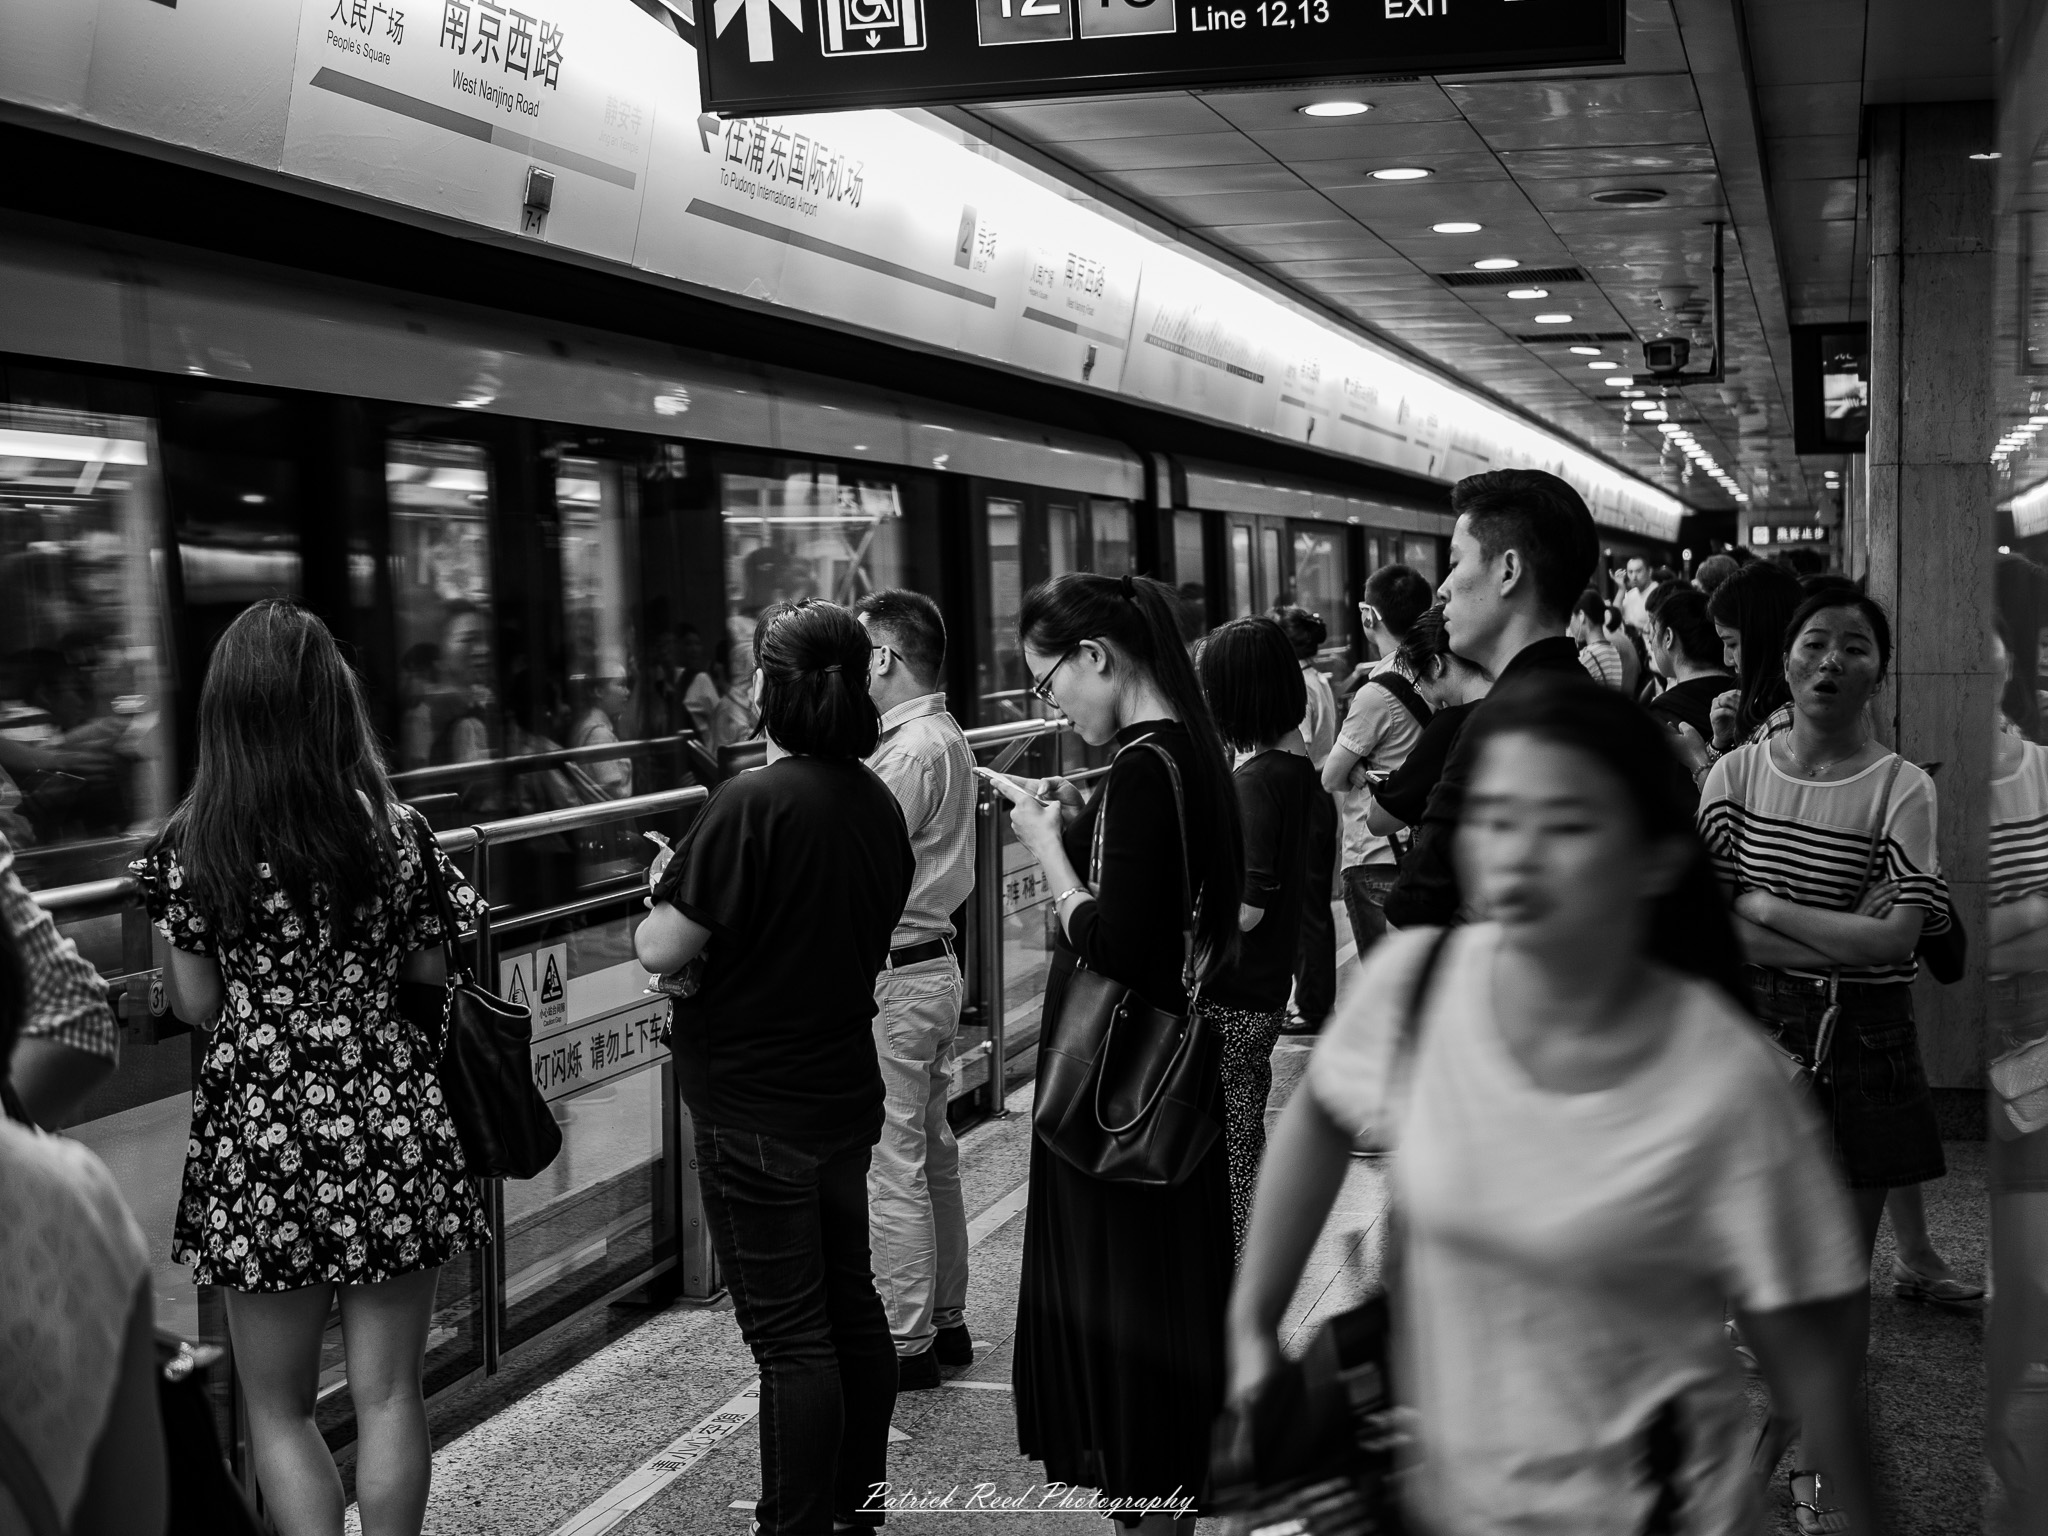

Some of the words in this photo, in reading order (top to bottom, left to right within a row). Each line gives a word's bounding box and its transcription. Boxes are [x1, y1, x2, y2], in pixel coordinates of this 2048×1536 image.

[329, 0, 404, 45] 人民广场
[1191, 6, 1246, 31] Line
[1256, 0, 1330, 28] 12,13
[326, 29, 361, 55] People's
[362, 43, 391, 66] Square
[439, 0, 564, 91] 南京西路
[452, 69, 477, 97] West
[479, 78, 514, 114] Nanjing
[515, 96, 540, 118] Road
[603, 94, 642, 136] 静安寺
[724, 116, 865, 209] 往浦东国际机场
[720, 167, 729, 186] To
[729, 171, 756, 200] Pudong
[757, 181, 796, 206] International
[797, 196, 818, 218] Airport
[525, 210, 543, 235] 7-1
[960, 220, 971, 254] 2
[152, 986, 165, 1009] 31
[534, 1040, 583, 1091] 灯闪烁
[590, 1012, 663, 1071] 请勿上下车
